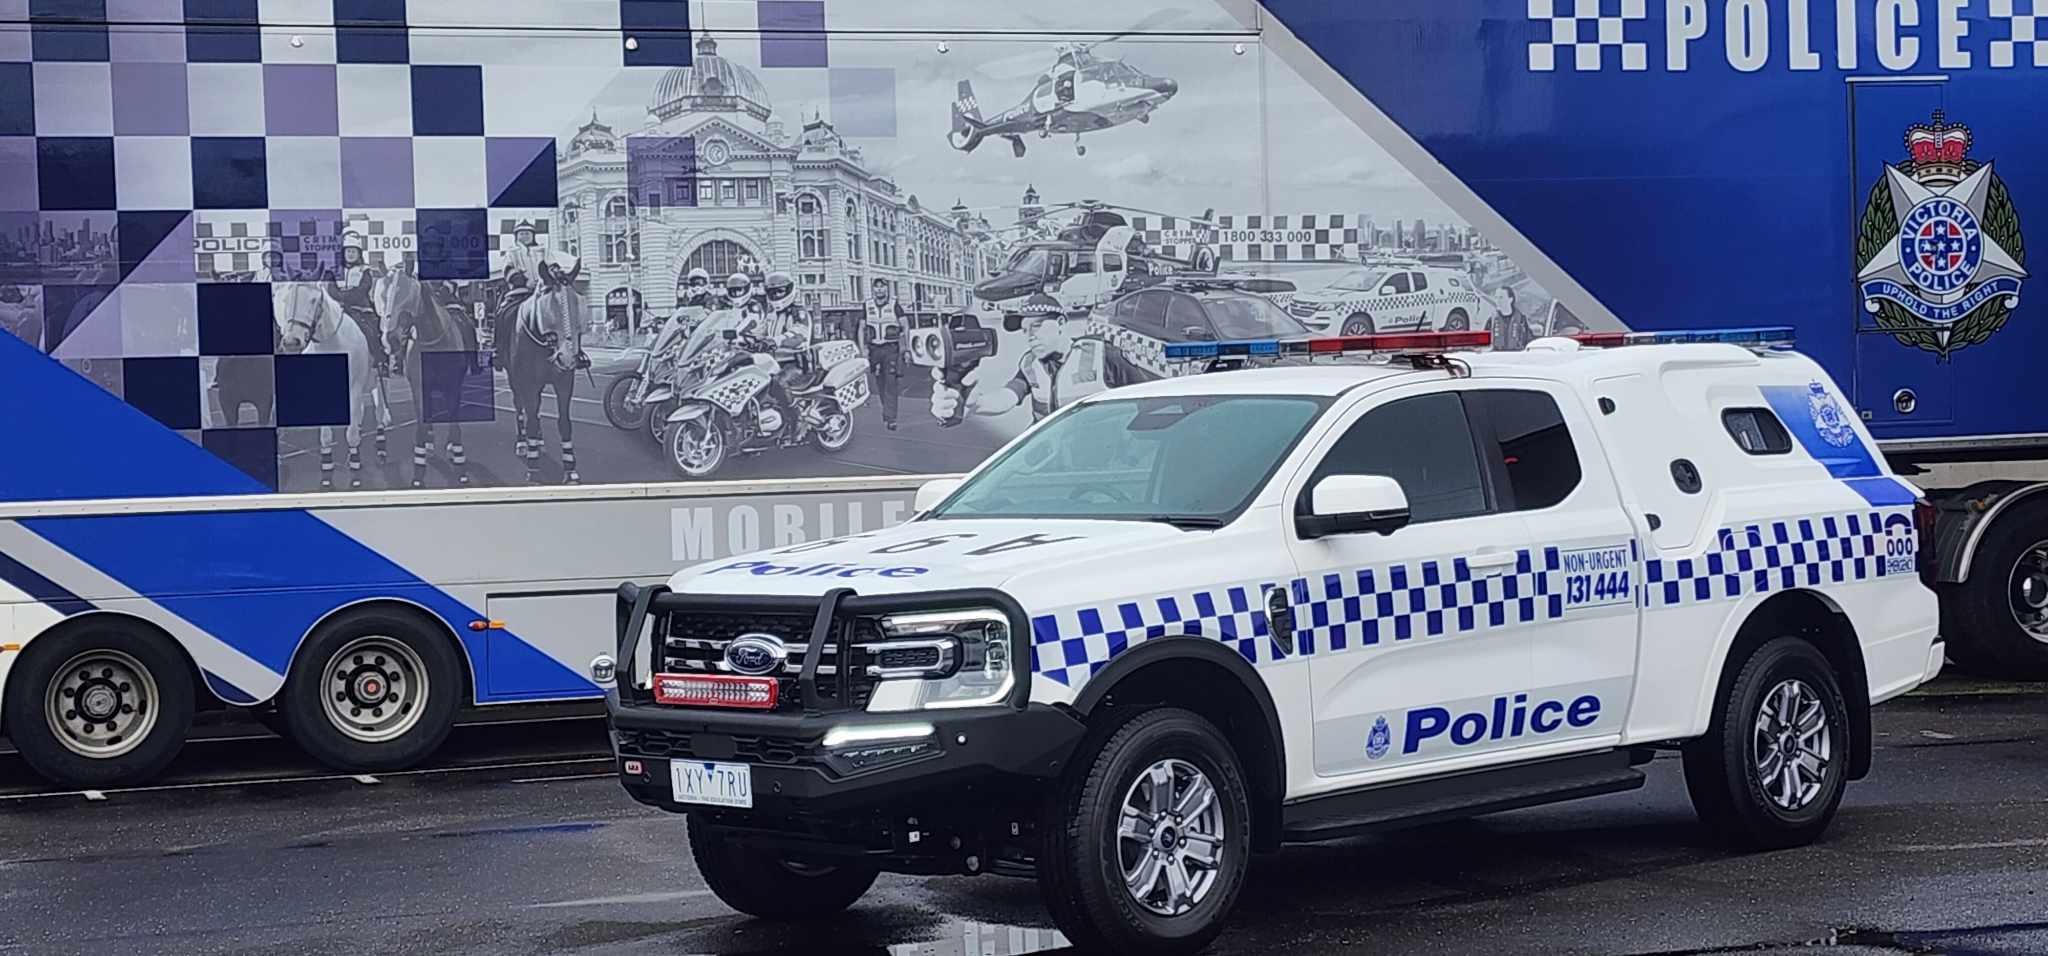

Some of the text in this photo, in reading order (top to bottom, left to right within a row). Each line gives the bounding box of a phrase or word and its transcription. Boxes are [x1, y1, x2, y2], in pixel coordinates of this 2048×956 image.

[1666, 0, 1972, 72] POLICE
[1902, 201, 1978, 241] VICTORIA
[303, 235, 338, 244] CRIM
[373, 237, 411, 249] 1800
[1223, 230, 1312, 243] 1800 333 000
[1909, 260, 1975, 291] POLICE
[1882, 281, 2000, 319] UPHOLD THE RIGHT
[1886, 537, 1913, 557] 000
[702, 561, 928, 578] Police
[1563, 549, 1627, 573] NON-URGENT
[1566, 570, 1629, 604] 131 444
[734, 647, 769, 665] Ford
[1402, 693, 1601, 755] Police
[675, 767, 748, 797] 1XY 7RU
